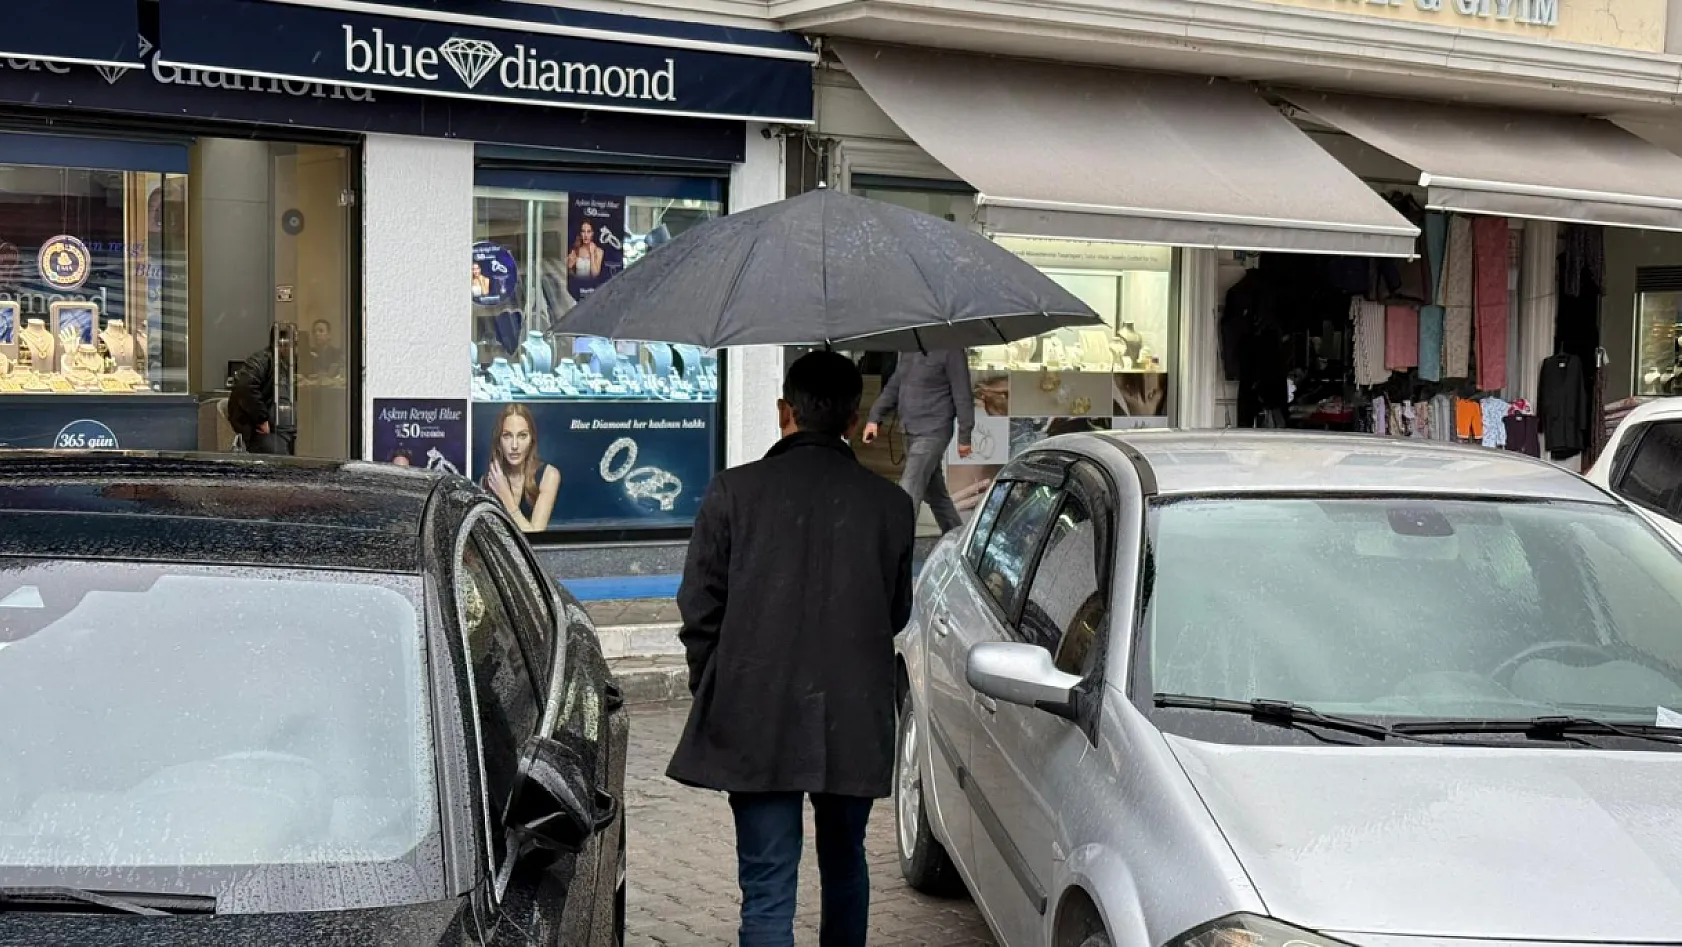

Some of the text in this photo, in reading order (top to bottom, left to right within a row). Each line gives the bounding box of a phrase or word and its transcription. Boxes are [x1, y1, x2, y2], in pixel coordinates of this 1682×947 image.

[342, 24, 677, 102] blue diamond
[439, 407, 462, 420] Blue
[571, 419, 590, 429] Blue
[592, 419, 632, 429] Diamond
[60, 433, 85, 448] 365
